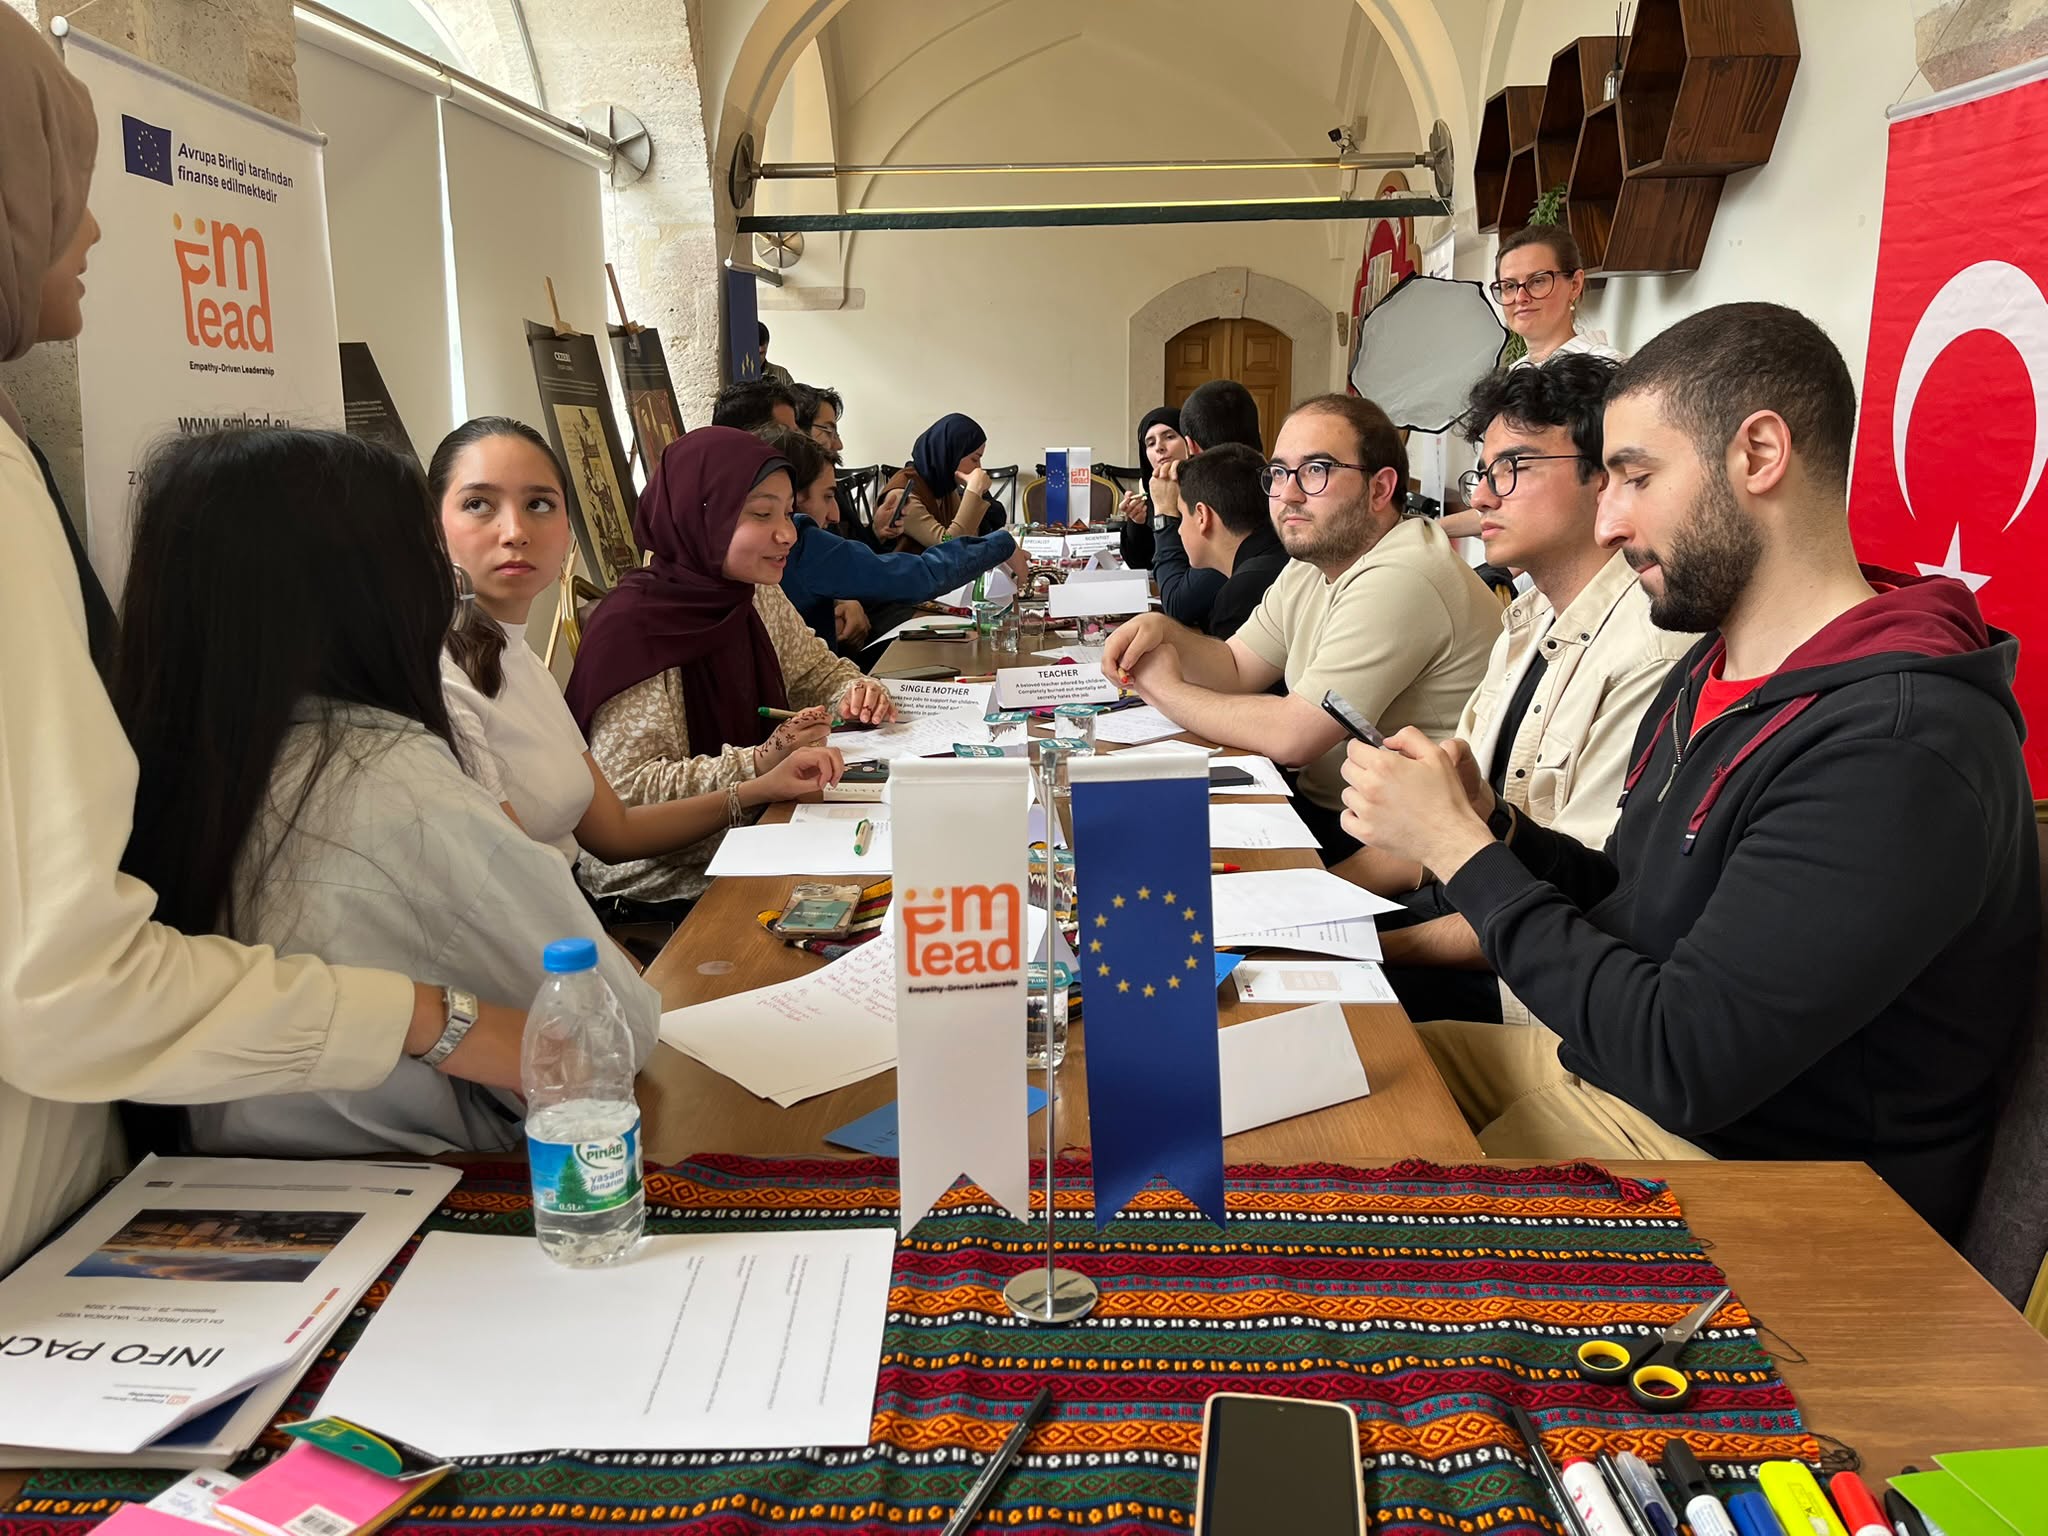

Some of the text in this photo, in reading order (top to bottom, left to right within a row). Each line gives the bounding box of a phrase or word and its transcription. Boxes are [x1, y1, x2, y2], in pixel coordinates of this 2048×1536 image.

[178, 143, 217, 166] Avrupa
[249, 163, 294, 188] tarafından
[178, 165, 278, 204] finanse edilmektedir
[189, 360, 275, 377] Empathy-Driven Leadership
[1038, 669, 1079, 679] TEACHER
[900, 684, 970, 696] SINGLE MOTHER
[908, 979, 1018, 994] Empathy-Driven Leadership
[84, 1313, 130, 1321] VALENCIA
[110, 1344, 225, 1368] INFO
